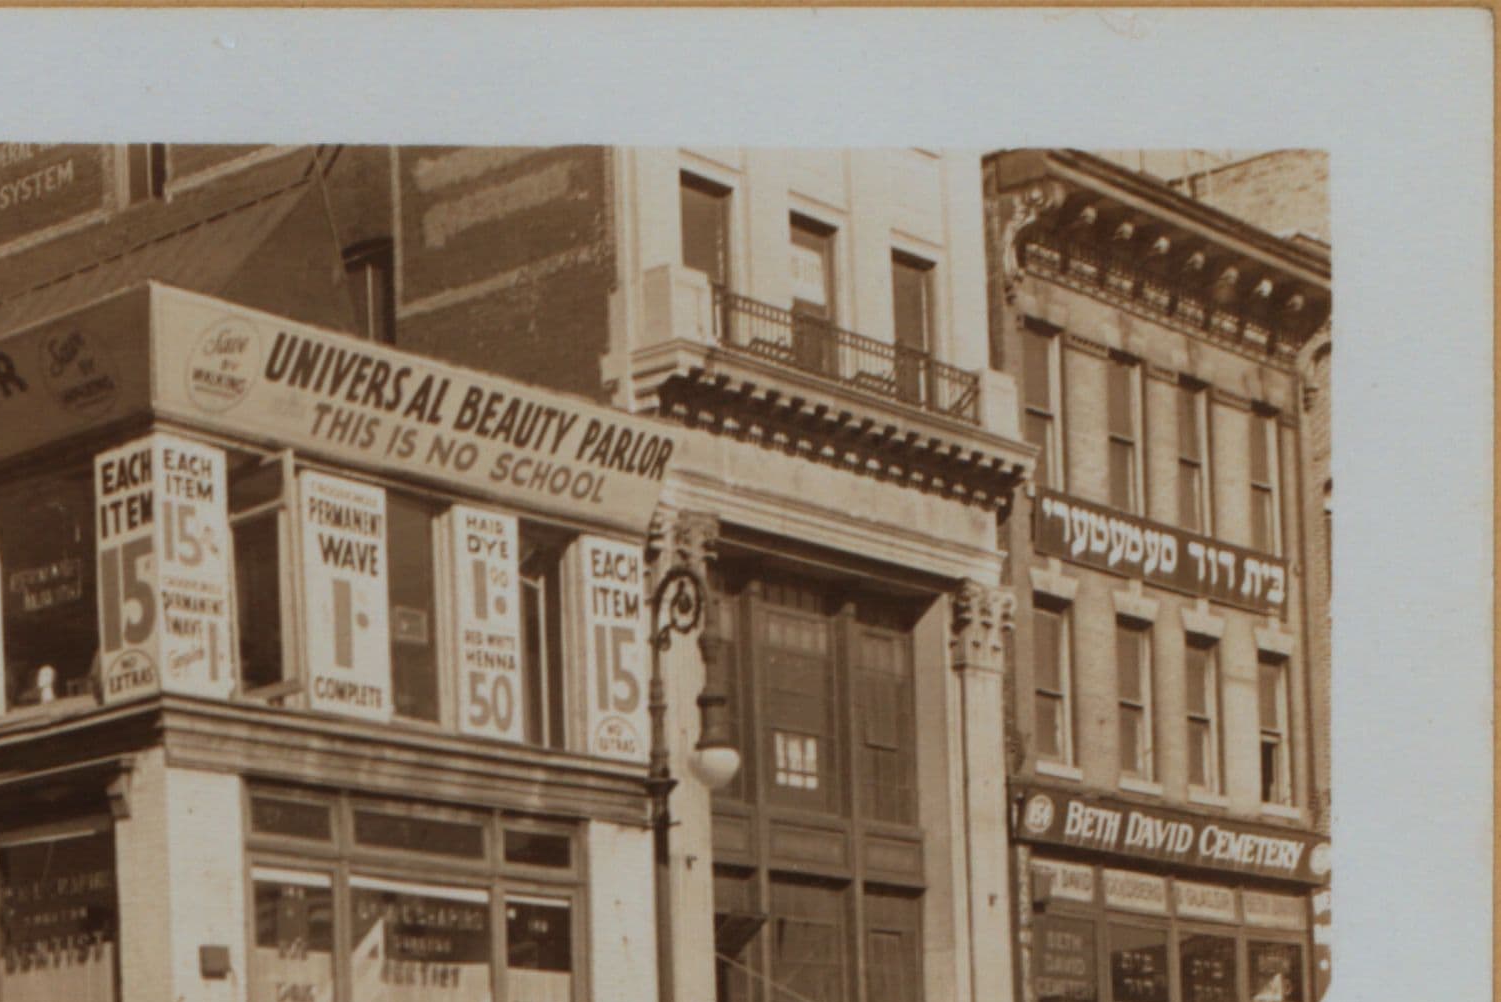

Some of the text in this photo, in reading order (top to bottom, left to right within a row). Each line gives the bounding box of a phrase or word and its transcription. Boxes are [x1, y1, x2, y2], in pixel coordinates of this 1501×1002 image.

[0, 160, 75, 211] SYSTEM
[265, 331, 675, 481] UNIVERSAL BEAUTY PARLOR
[100, 450, 154, 496] EACH
[162, 449, 213, 477] EACH
[310, 401, 605, 504] THIS IS NO SCHOOL
[165, 474, 214, 503] ITEM
[308, 497, 383, 540] PERMANENT
[466, 516, 504, 535] HAIR
[318, 533, 379, 577] WAVE
[467, 534, 508, 560] DYE
[590, 549, 638, 584] EACH
[1187, 541, 1236, 590] דוד
[101, 534, 157, 654] 15
[591, 586, 640, 620] ITEM
[1240, 557, 1286, 604] בית
[466, 651, 516, 671] HENNA
[594, 624, 641, 715] 15
[313, 676, 383, 709] COMPLETE
[468, 671, 513, 732] 50
[1064, 800, 1305, 871] BETH DAVID CEMETERY
